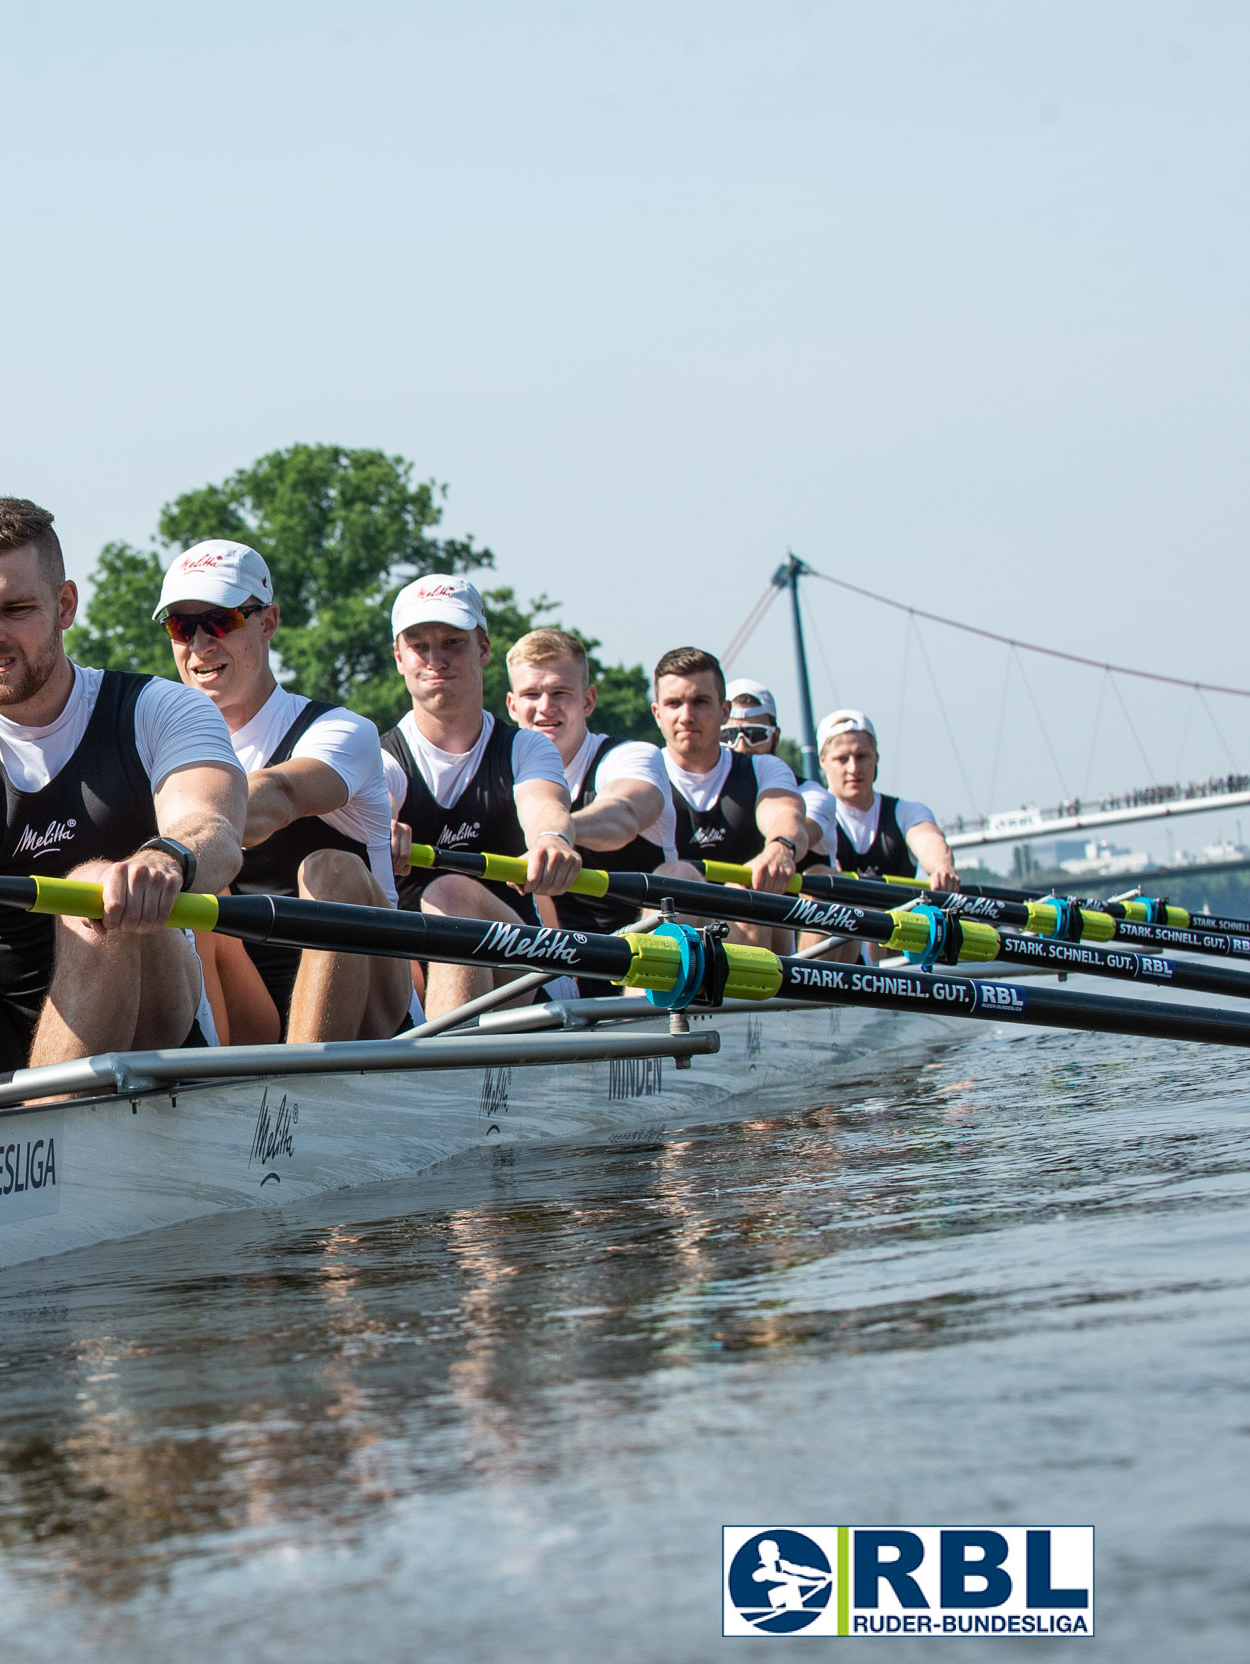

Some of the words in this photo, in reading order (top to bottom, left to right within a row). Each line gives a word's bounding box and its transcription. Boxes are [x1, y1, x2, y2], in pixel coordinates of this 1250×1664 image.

[1119, 922, 1154, 938] STARK.
[1155, 928, 1202, 946] SCHNELL.
[1203, 936, 1226, 949] GUT.
[1004, 938, 1046, 956] STARK.
[1049, 945, 1104, 966] SCHNELL.
[1106, 954, 1134, 970] GUT.
[1141, 957, 1173, 975] RBL
[790, 966, 848, 990] STARK.
[851, 973, 930, 999] SCHNELL.
[932, 982, 970, 1003] GUT.
[980, 985, 1023, 1006] RBL
